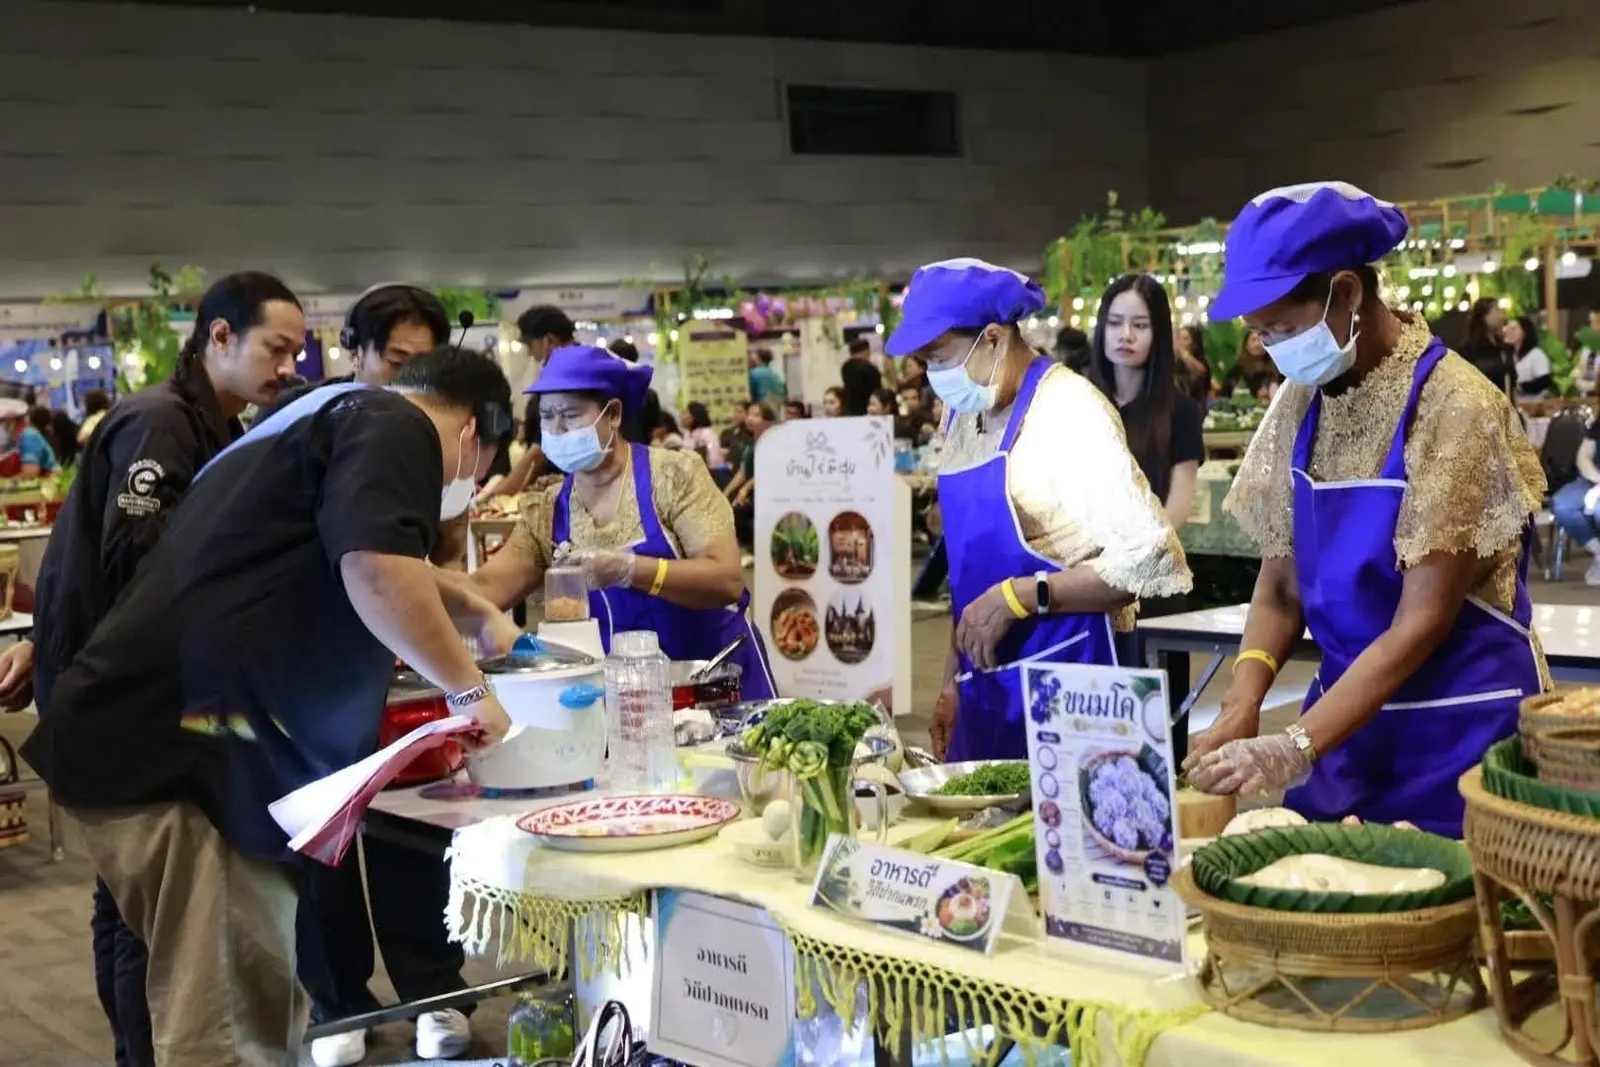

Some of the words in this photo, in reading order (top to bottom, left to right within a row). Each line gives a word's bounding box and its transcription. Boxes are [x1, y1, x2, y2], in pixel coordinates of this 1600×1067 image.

[1063, 681, 1136, 724] ขนมโค
[871, 858, 940, 889] อาหารดี
[696, 946, 747, 974] อาหารดี
